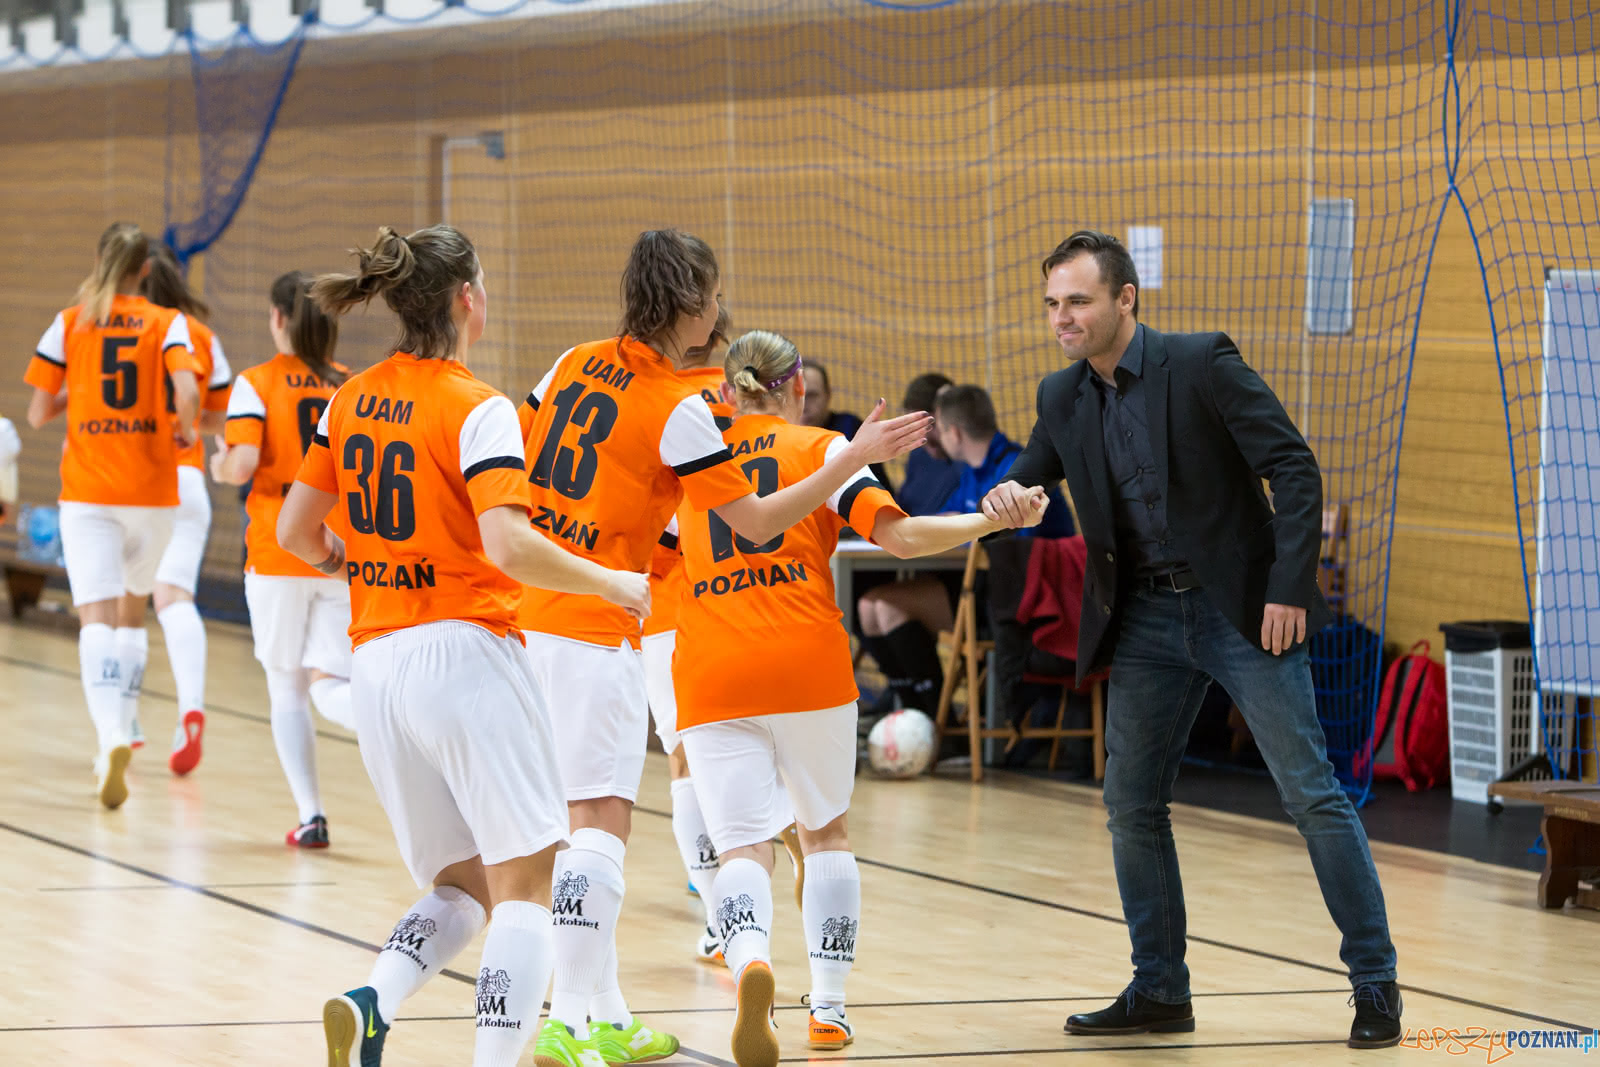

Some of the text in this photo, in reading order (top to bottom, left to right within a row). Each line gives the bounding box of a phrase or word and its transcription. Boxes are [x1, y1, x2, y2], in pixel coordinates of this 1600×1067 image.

[101, 335, 139, 411] 5
[582, 355, 636, 392] UAM
[355, 393, 415, 425] UAM
[528, 380, 619, 501] 13
[343, 432, 416, 542] 36
[530, 504, 601, 552] ZNAŃ
[693, 558, 809, 599] POZNAŃ
[559, 917, 600, 931] Kobiet
[484, 1018, 522, 1030] Kobiet
